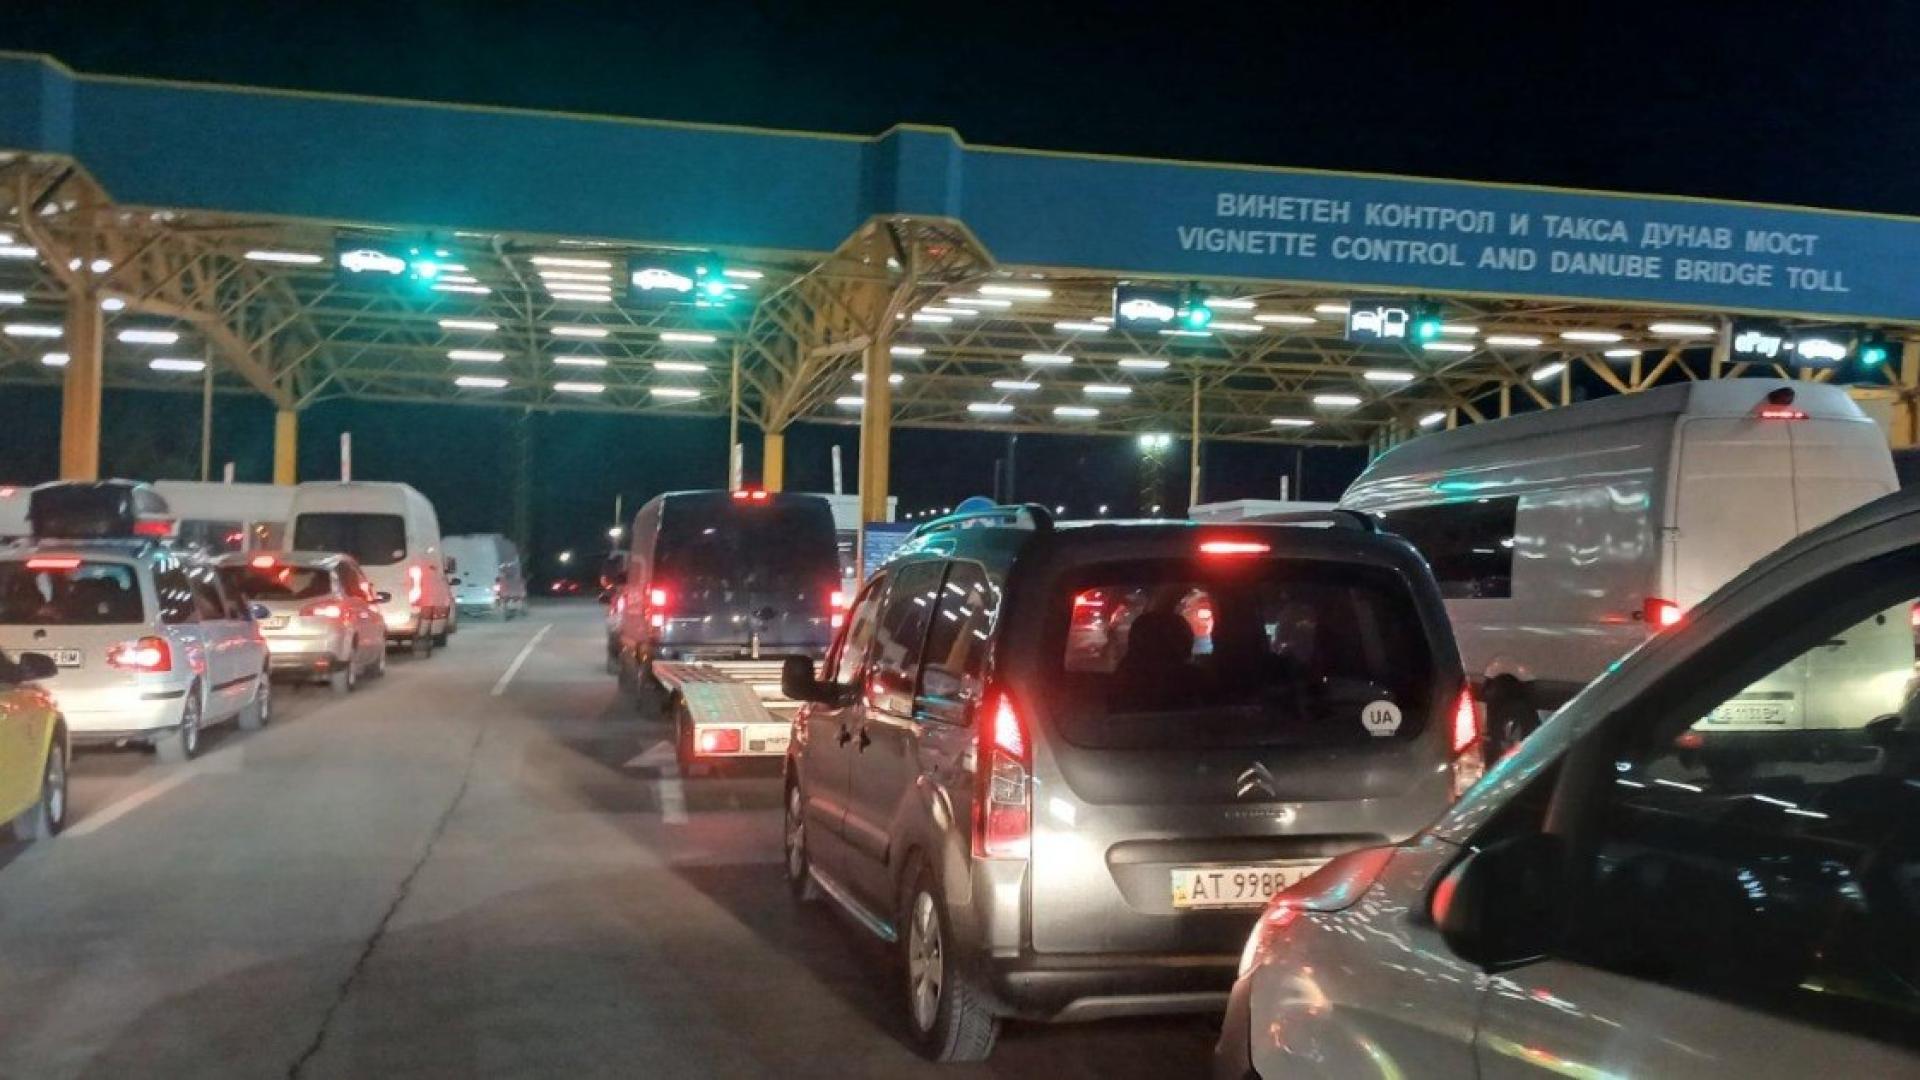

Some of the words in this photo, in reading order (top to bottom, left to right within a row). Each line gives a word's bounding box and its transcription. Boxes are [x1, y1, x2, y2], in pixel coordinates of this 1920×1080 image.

[1217, 193, 1350, 223] ВИНЕТЕН
[1365, 203, 1495, 233] КОНТРОЛ
[1509, 213, 1529, 236] И
[1542, 216, 1628, 242] ТАКСА
[1640, 222, 1732, 249] ДУНАВ
[1745, 230, 1818, 256] МОСТ
[1177, 226, 1316, 257] VIGNETTE
[1332, 237, 1464, 266] CONTROL
[1477, 248, 1536, 271] AND
[1551, 251, 1662, 279] DANUBE
[1674, 259, 1773, 286] BRIDGE
[1786, 267, 1849, 292] TOLL
[1370, 709, 1393, 725] UA
[1191, 873, 1224, 899] AT
[1233, 872, 1286, 898] 9988
